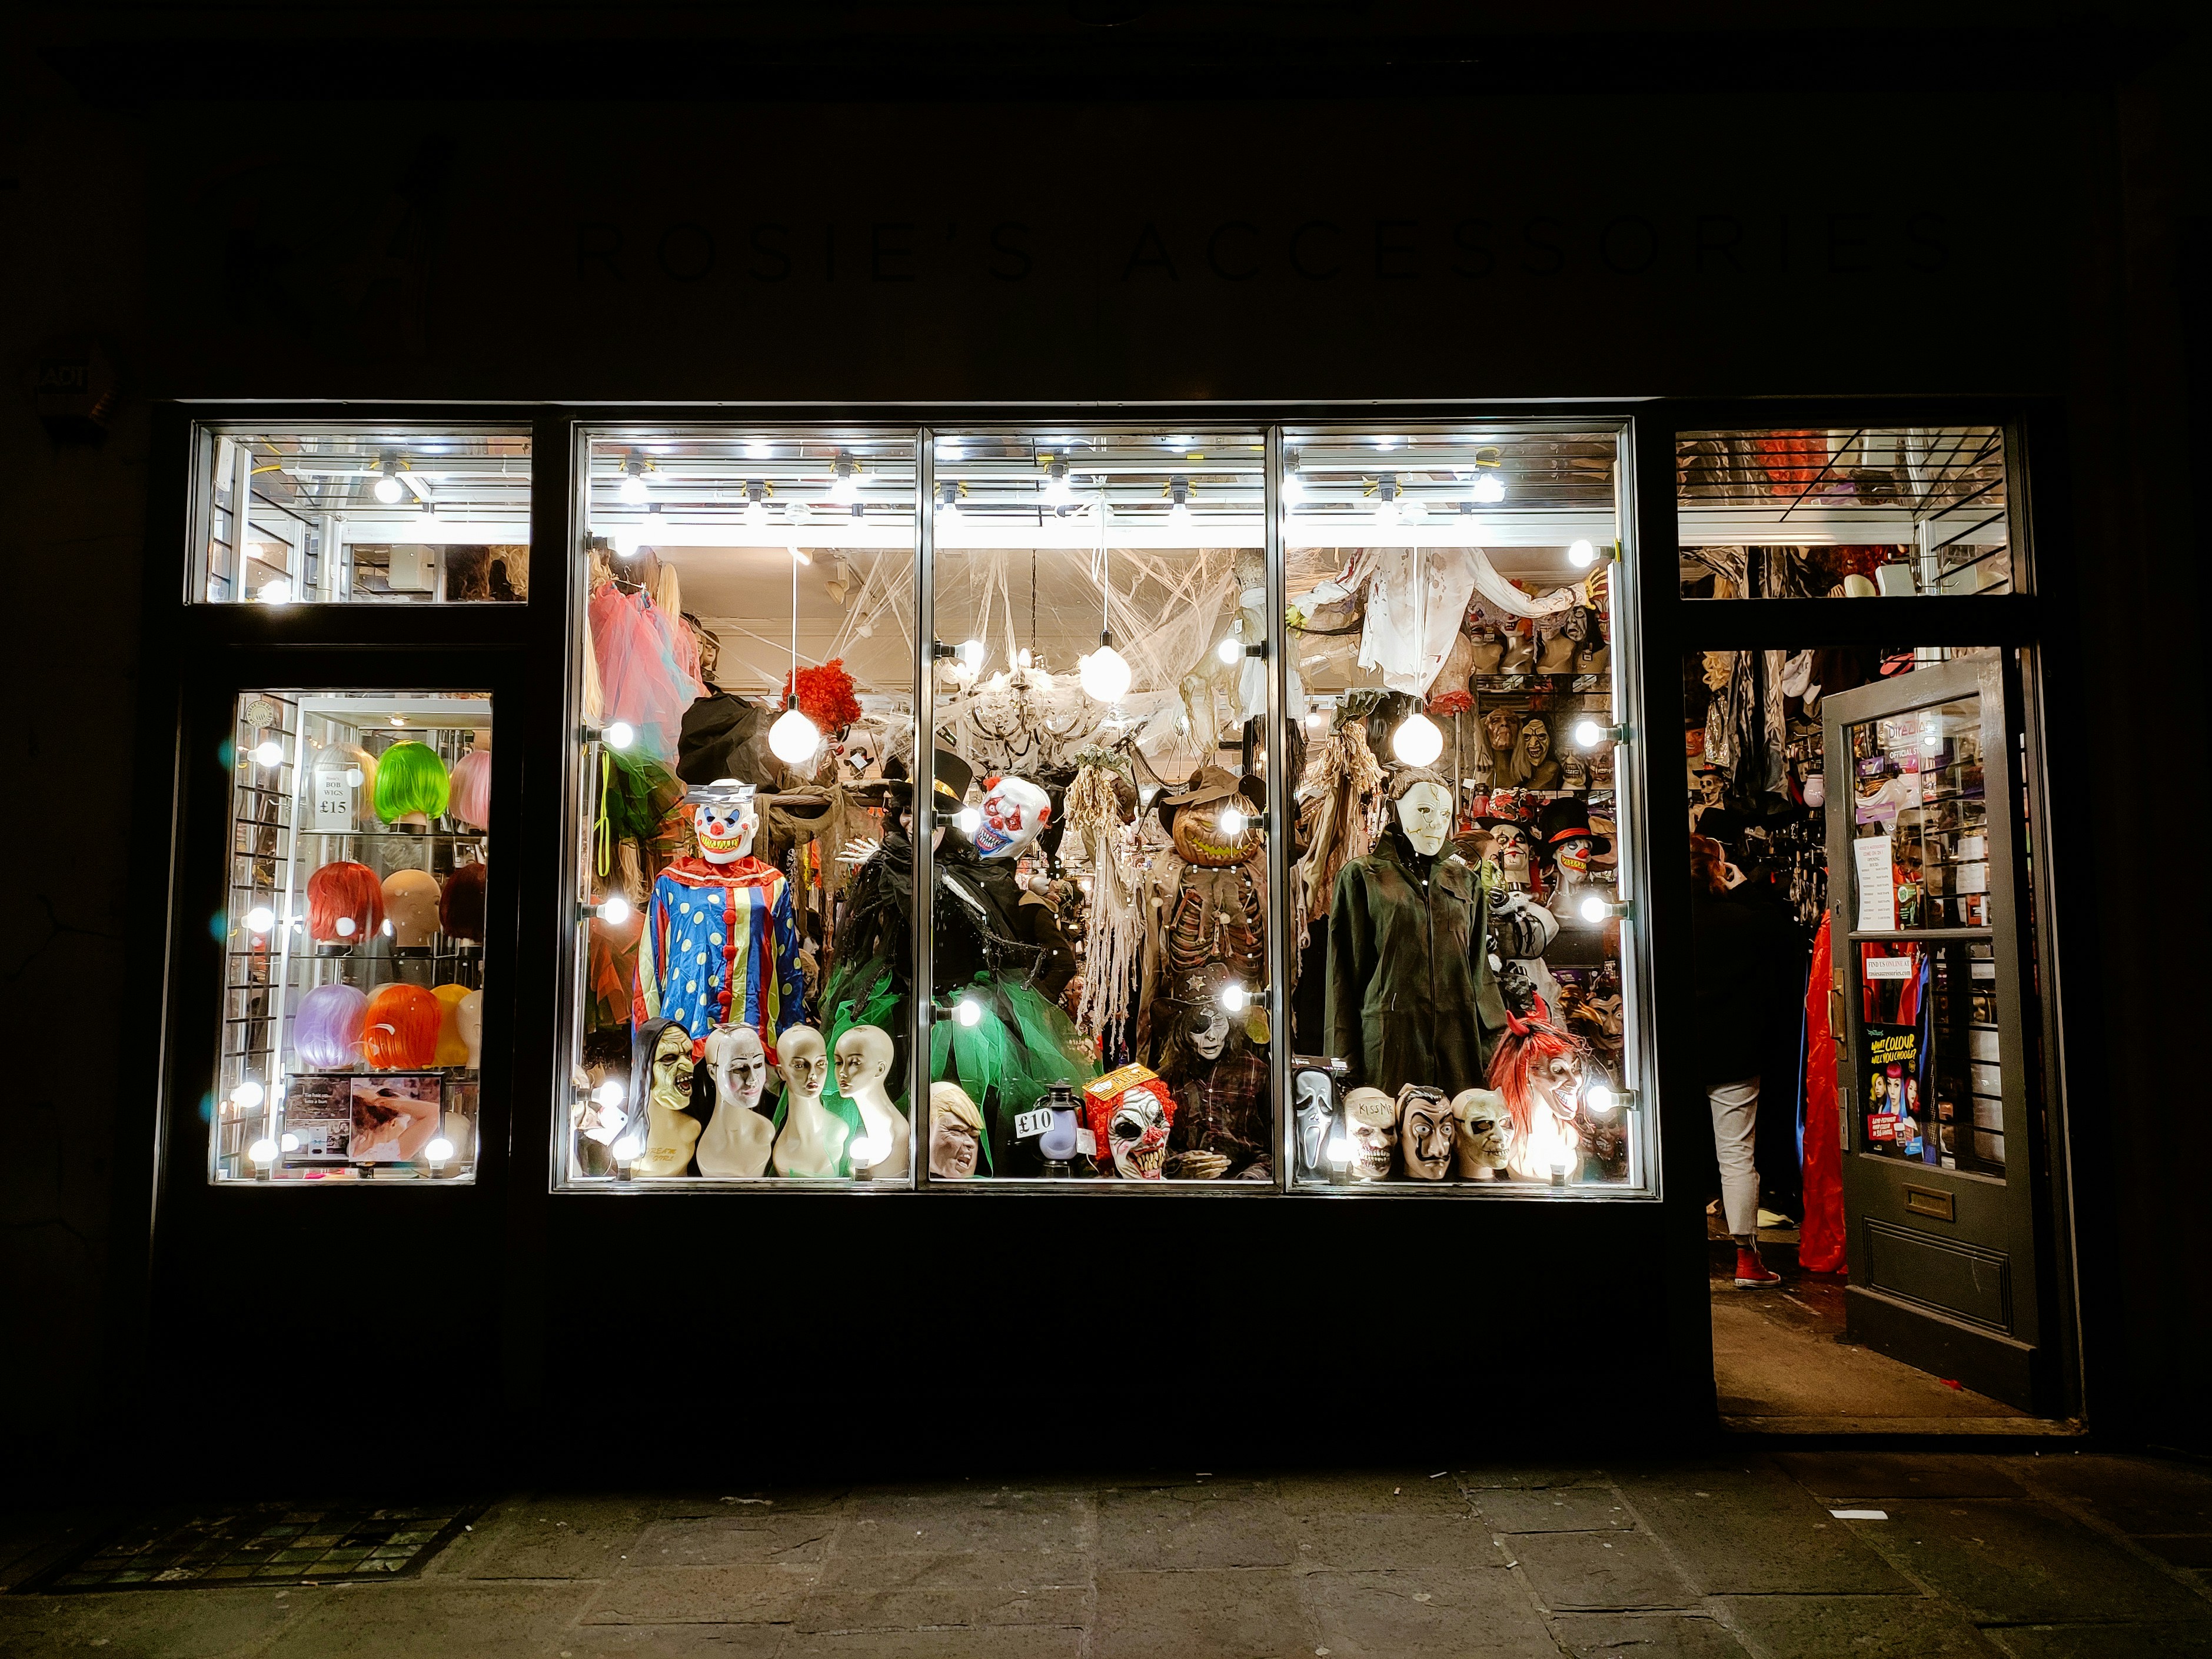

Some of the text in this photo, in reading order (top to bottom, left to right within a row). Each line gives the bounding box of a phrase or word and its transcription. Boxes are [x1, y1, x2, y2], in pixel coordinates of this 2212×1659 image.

[574, 212, 1950, 282] ROSIE'S ACCESSORIES
[1890, 749, 1913, 759] OFFICIAL
[320, 800, 347, 814] £15
[1871, 1034, 1915, 1052] WHAT COLOUR
[1871, 1048, 1917, 1064] WILL YOU CHOOSE?
[1019, 1111, 1052, 1134] £10
